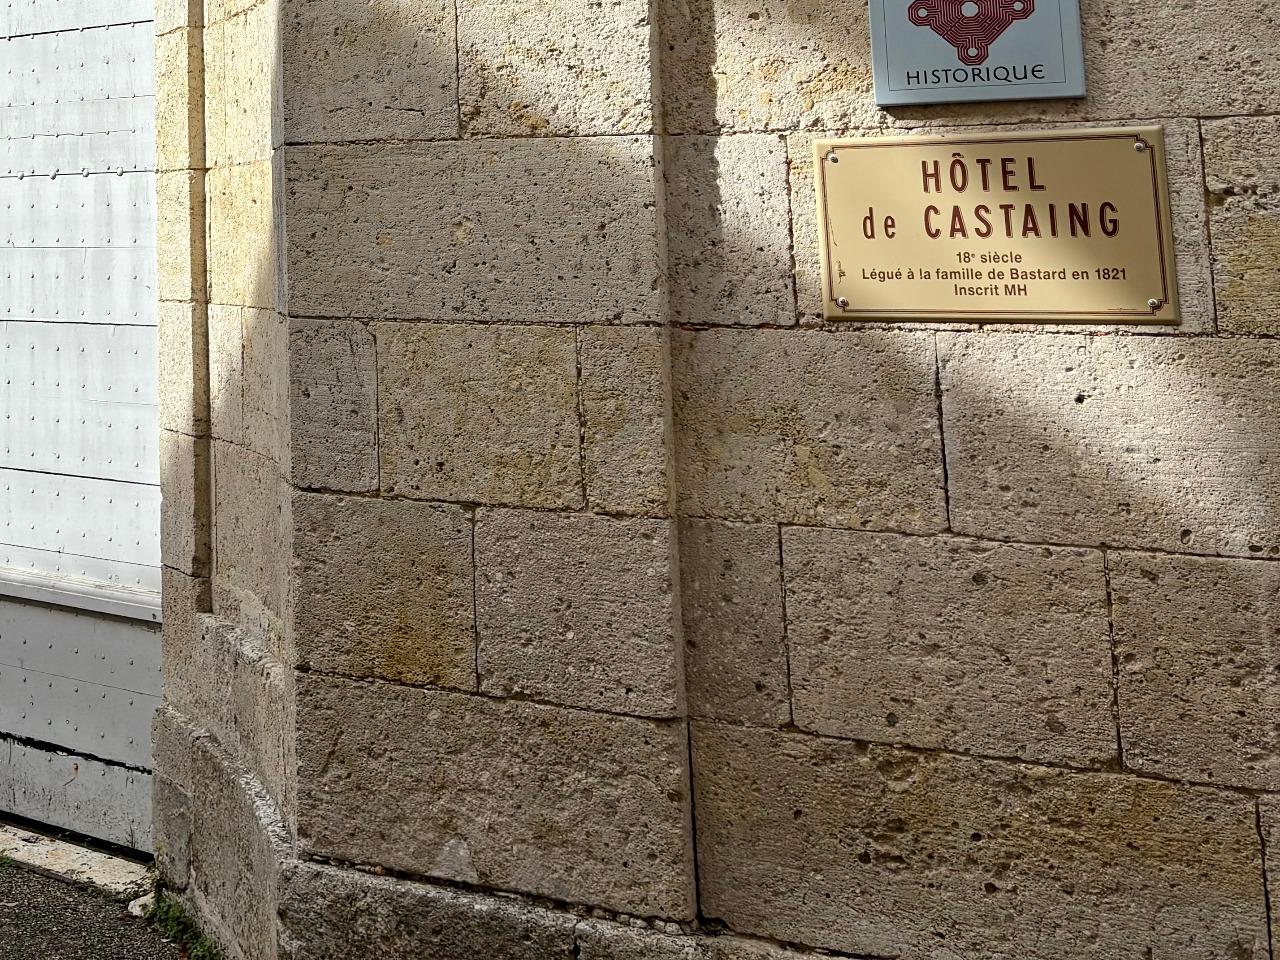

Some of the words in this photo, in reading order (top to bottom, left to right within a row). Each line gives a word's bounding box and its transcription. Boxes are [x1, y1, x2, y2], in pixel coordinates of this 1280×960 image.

[906, 64, 1045, 86] HISTORIQUE
[921, 152, 1046, 194] HÔTEL
[862, 206, 897, 240] de
[923, 201, 1121, 239] CASTAING
[980, 251, 1022, 264] siècle
[862, 268, 902, 282] Légué
[907, 268, 915, 280] à
[920, 268, 931, 280] la
[935, 268, 983, 280] famille
[987, 268, 1005, 280] de
[1010, 268, 1067, 280] Bastard
[1072, 270, 1089, 280] en
[1095, 268, 1126, 280] 1821
[954, 283, 1000, 296] Inscrit
[1004, 284, 1028, 296] MH
